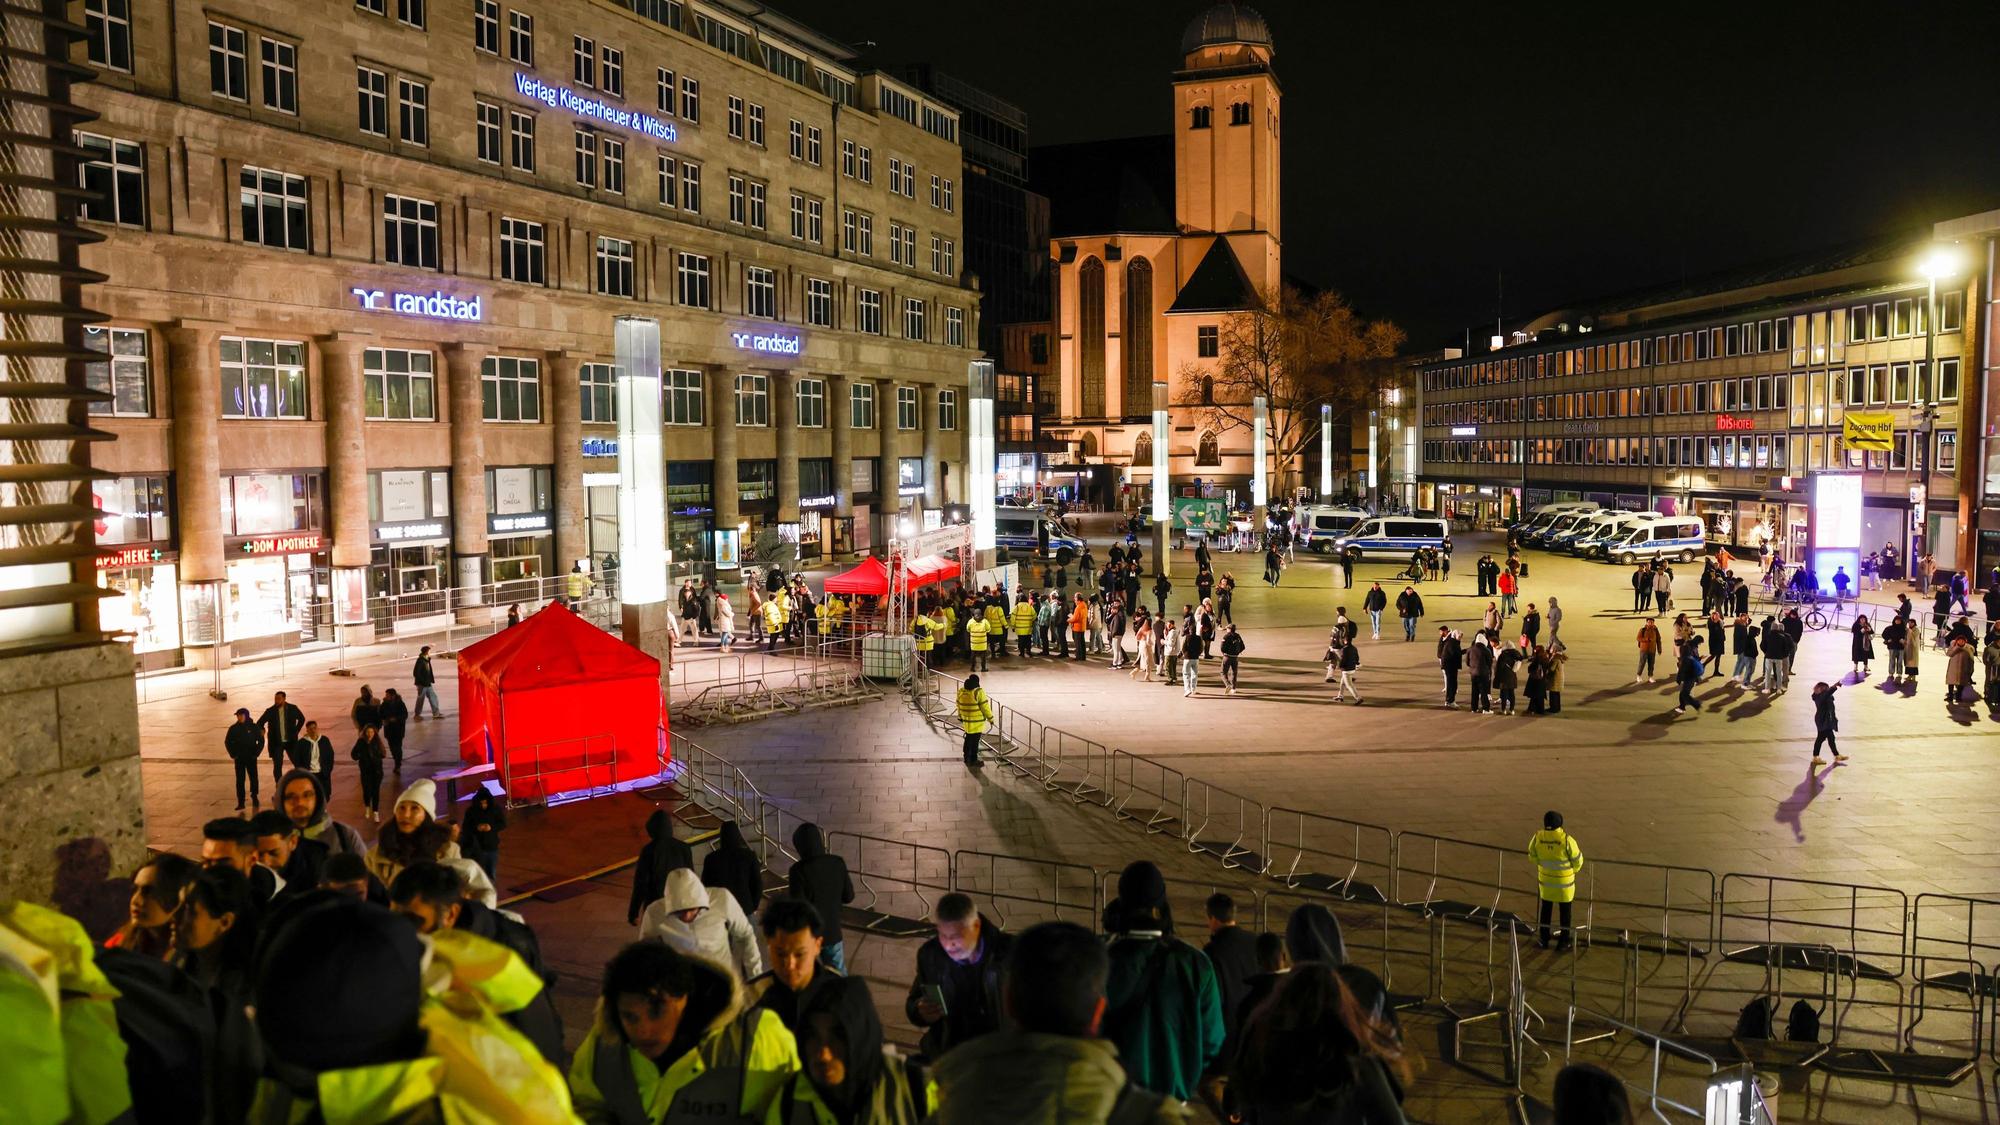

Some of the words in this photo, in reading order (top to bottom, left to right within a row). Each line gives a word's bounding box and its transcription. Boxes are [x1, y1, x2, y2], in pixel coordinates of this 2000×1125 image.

[516, 72, 556, 107] Verlag
[560, 87, 630, 127] Kiepenheuer
[632, 112, 641, 131] &
[642, 115, 677, 142] Witsch
[395, 291, 480, 320] randstad
[753, 333, 799, 354] randstad
[1716, 414, 1733, 430] ibis
[1850, 422, 1876, 433] Zugang
[1878, 422, 1892, 432] Hbf
[252, 539, 274, 554] DOM
[277, 536, 320, 552] APOTHEKE
